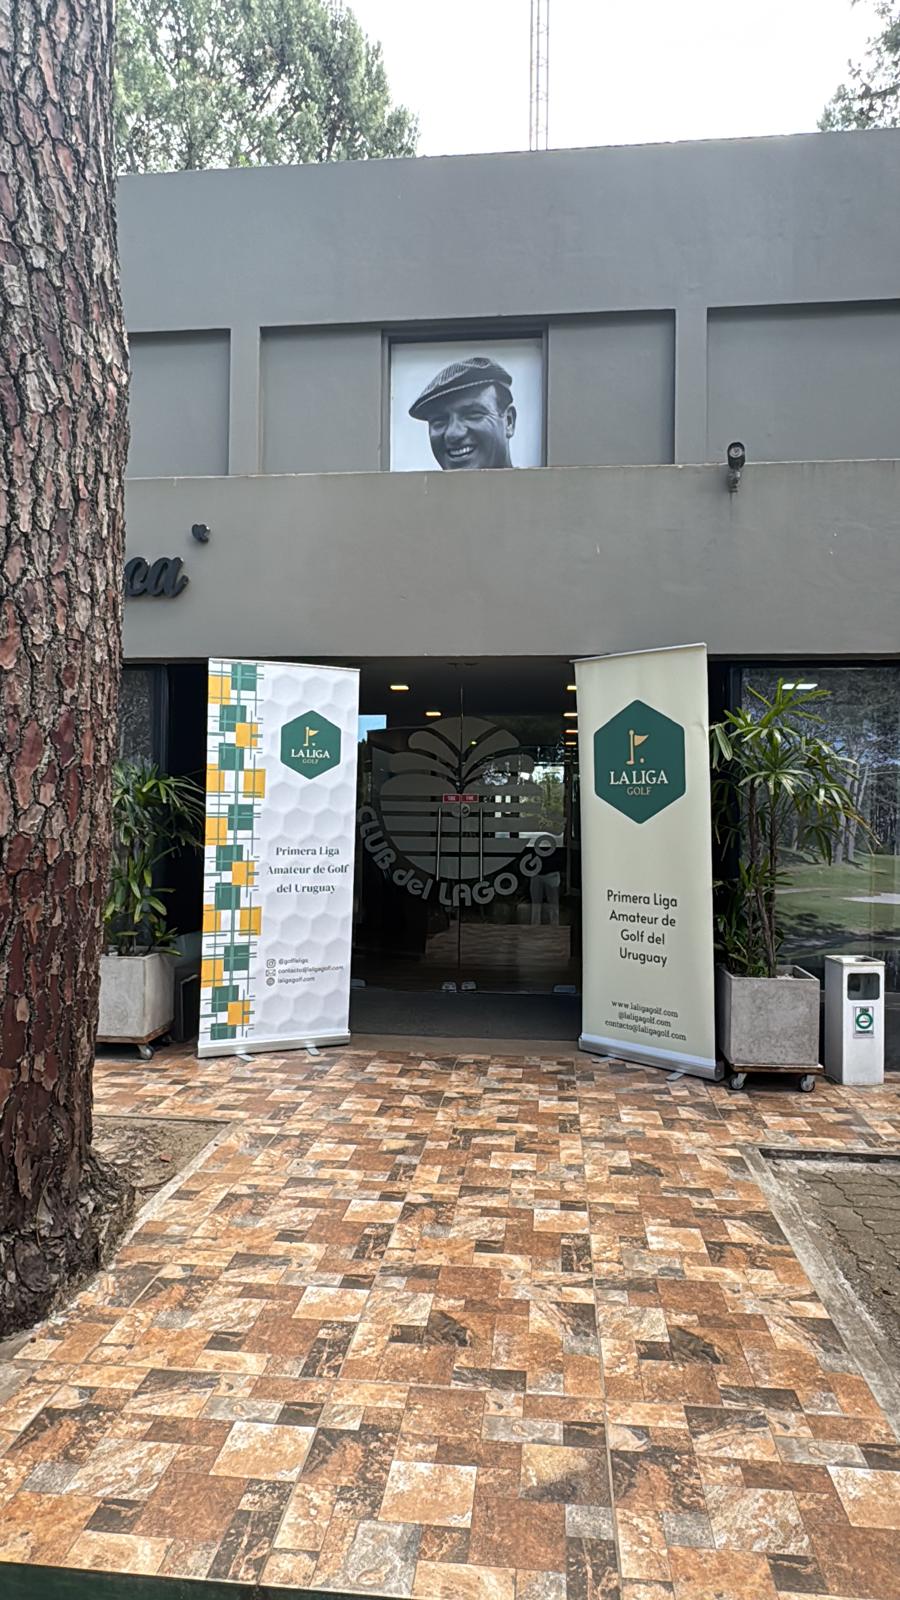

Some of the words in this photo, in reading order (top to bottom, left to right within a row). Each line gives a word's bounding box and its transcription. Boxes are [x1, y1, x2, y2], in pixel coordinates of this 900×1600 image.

[123, 556, 189, 598] ca
[626, 786, 652, 796] GOLF
[275, 846, 317, 856] Primera
[319, 845, 340, 857] Liga
[357, 805, 397, 870] CLUB
[392, 868, 433, 900] del
[439, 872, 519, 907] LAGO
[267, 865, 311, 875] Amateur
[312, 864, 325, 874] de
[327, 863, 350, 874] Golf
[276, 883, 292, 893] del
[294, 883, 336, 895] Uruguay
[607, 889, 650, 905] Primera
[653, 892, 678, 910] Liga
[609, 909, 659, 925] Amateur
[661, 914, 676, 927] de
[620, 928, 645, 943] Golf
[647, 932, 665, 945] del
[619, 946, 668, 968] Uruguay
[611, 1000, 679, 1018] www.laligagolf.com
[618, 1011, 672, 1028] @laligagolf.com
[604, 1019, 687, 1041] contacto@laligagolf.com
